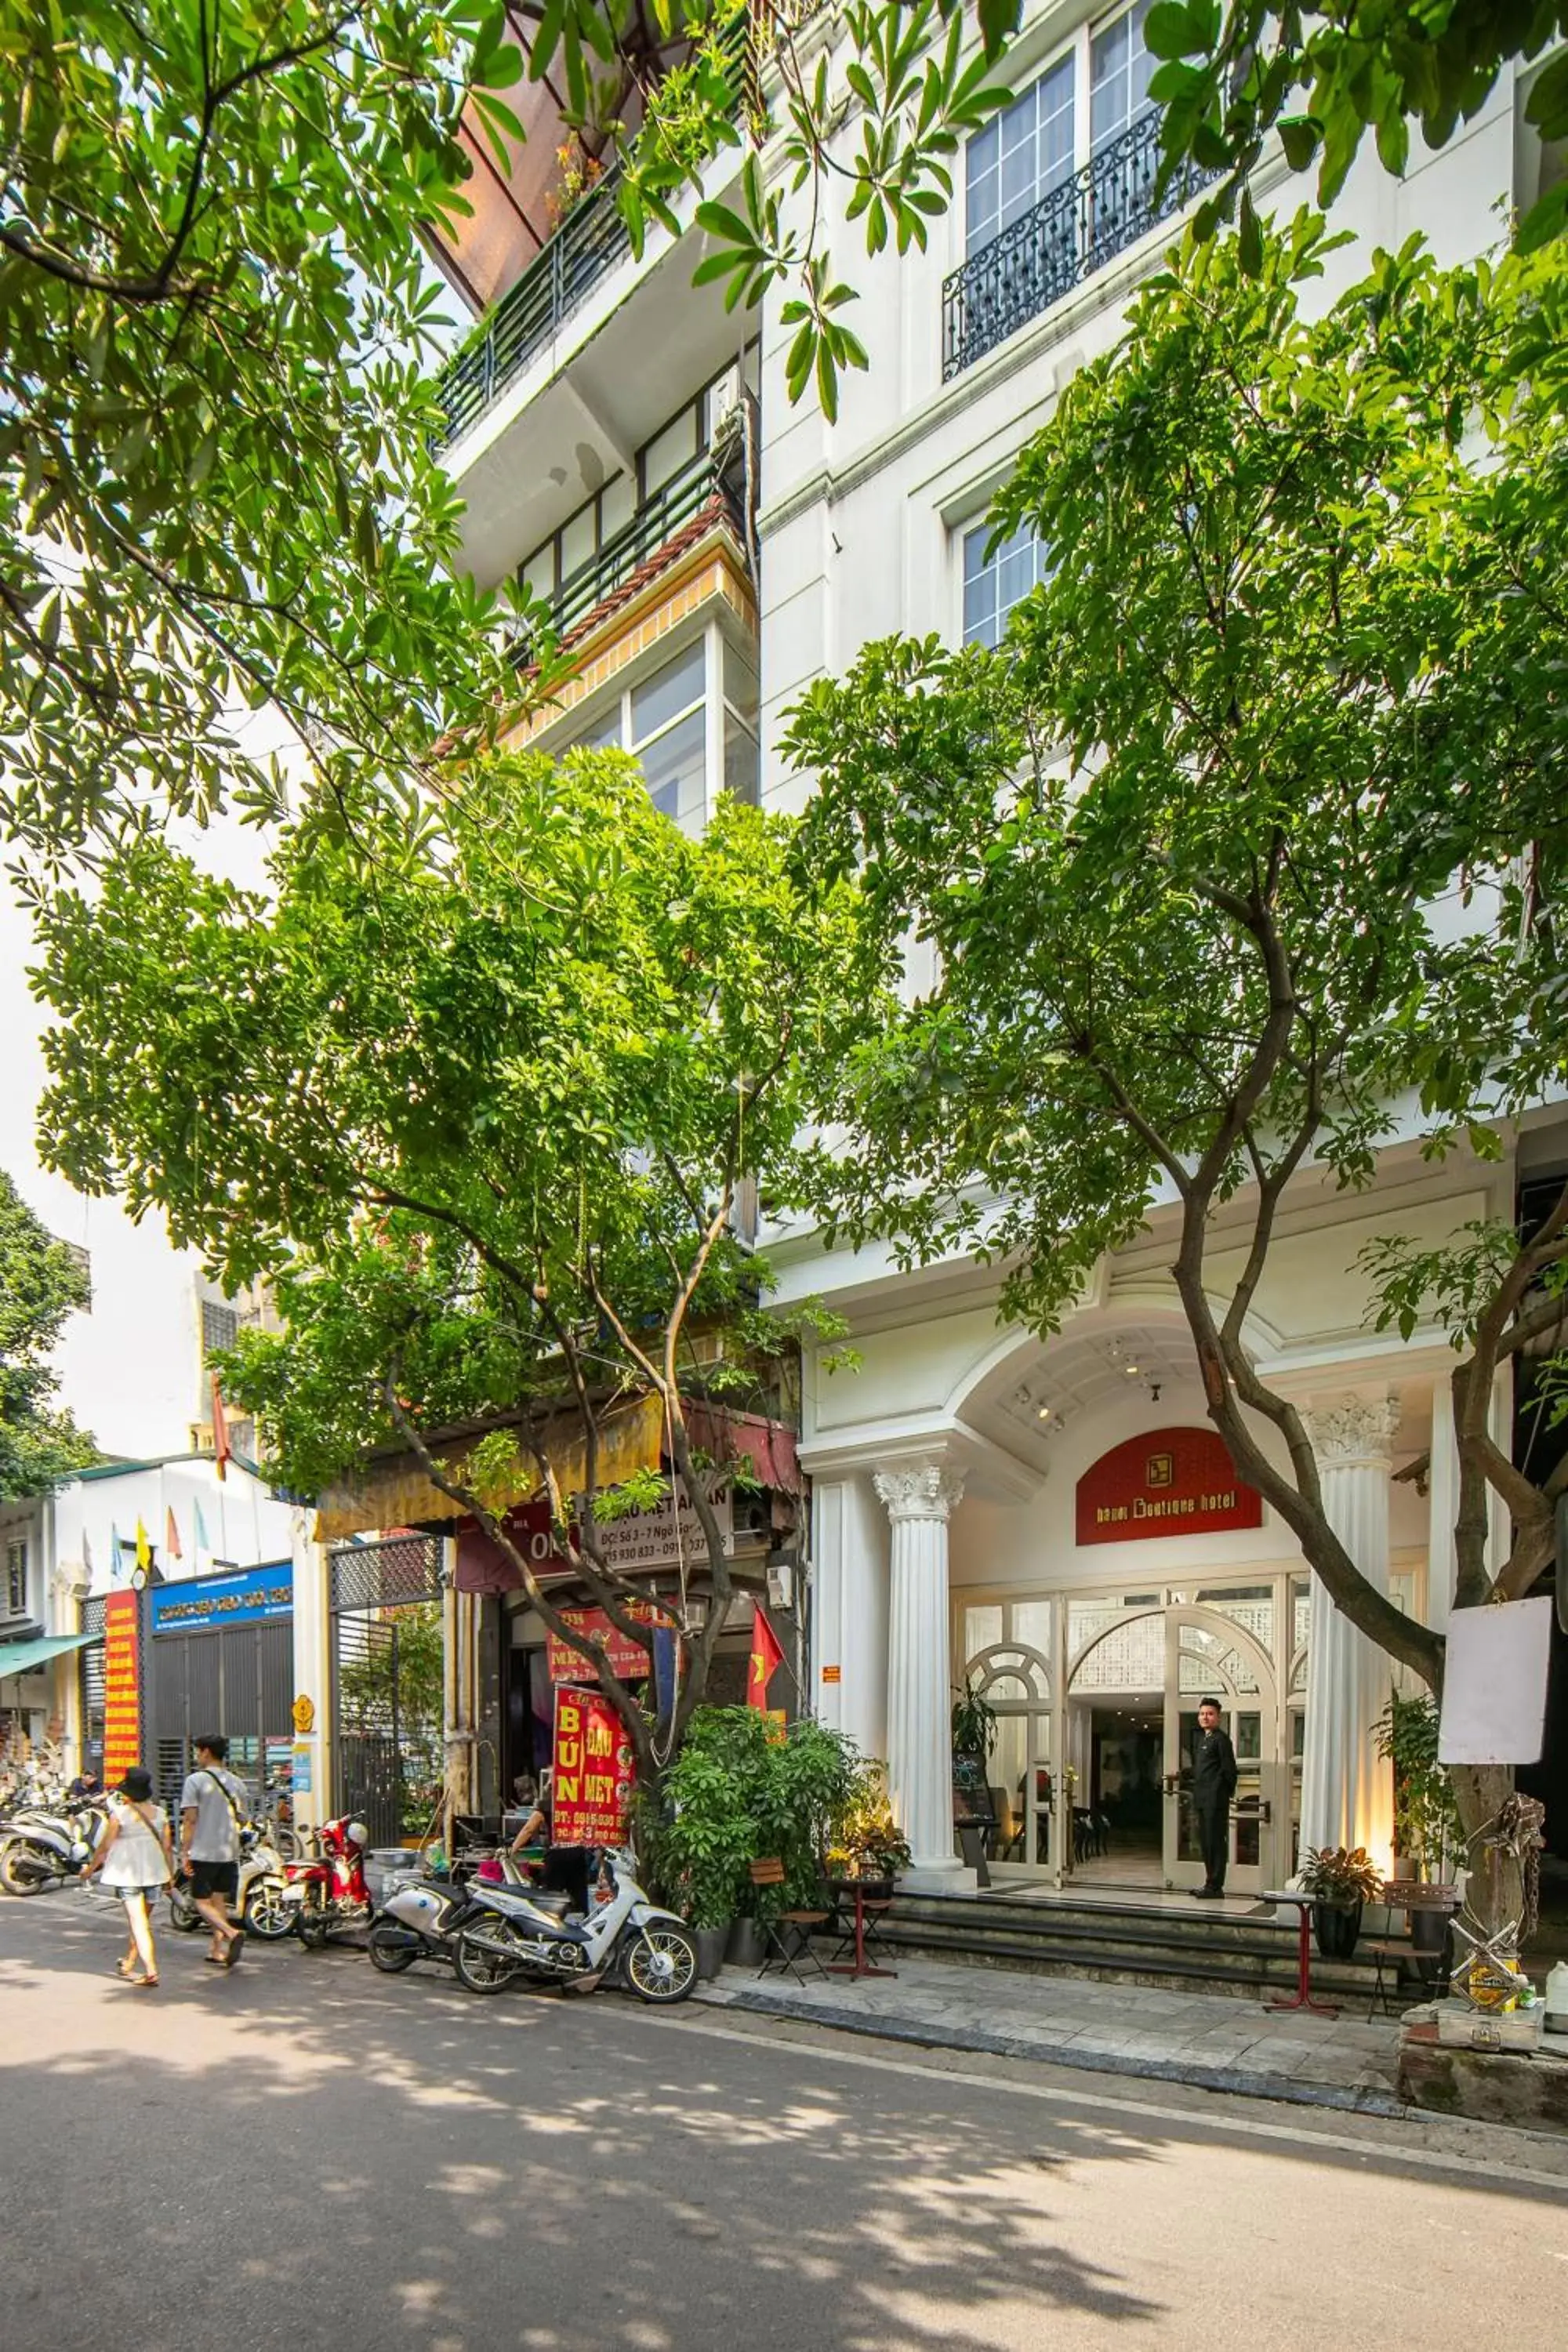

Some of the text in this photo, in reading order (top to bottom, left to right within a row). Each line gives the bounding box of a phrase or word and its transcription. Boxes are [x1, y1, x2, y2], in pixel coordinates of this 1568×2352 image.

[1134, 1497, 1194, 1519] Boutique
[1200, 1490, 1236, 1512] hotel
[653, 1523, 673, 1541] Ngõ
[637, 1544, 655, 1559] 833
[557, 1705, 580, 1803] BÚN
